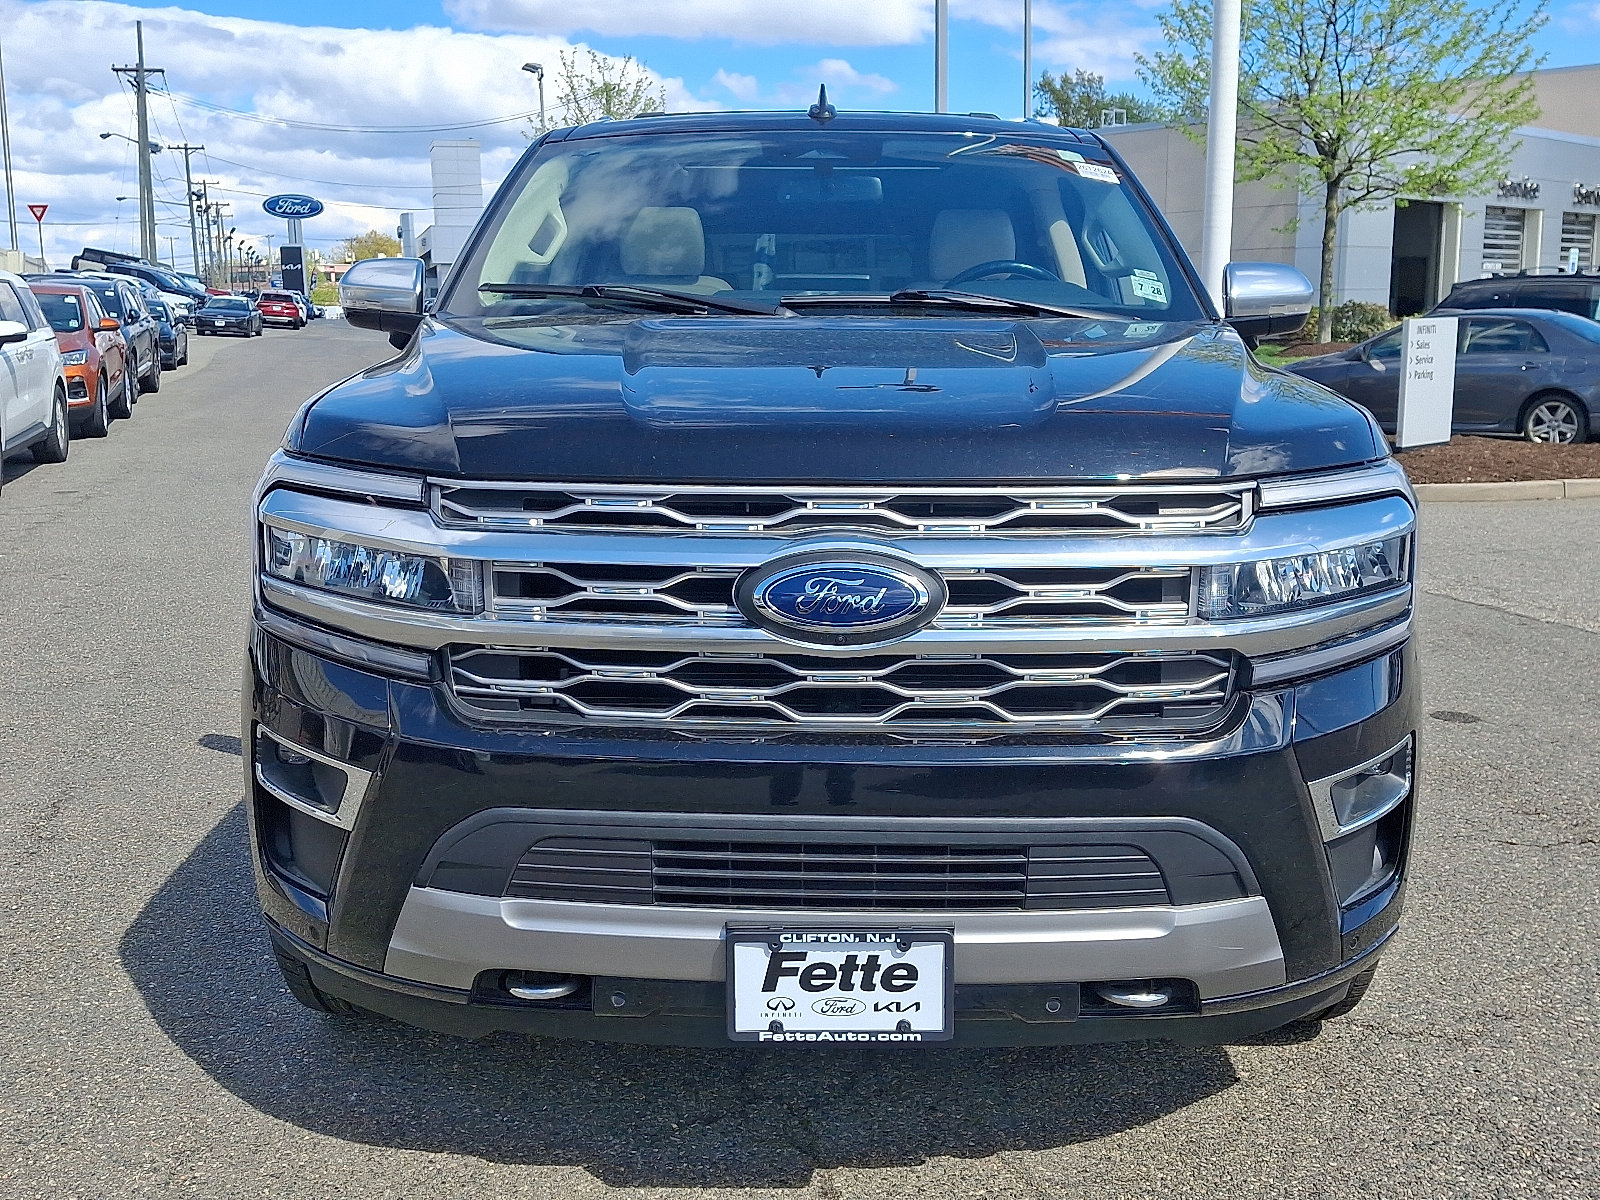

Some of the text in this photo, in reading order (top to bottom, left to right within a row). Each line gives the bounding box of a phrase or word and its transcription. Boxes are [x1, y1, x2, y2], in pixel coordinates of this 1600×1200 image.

[276, 198, 311, 214] Ford
[1137, 282, 1163, 296] 7 28
[1416, 339, 1431, 350] Sales
[1415, 354, 1434, 365] Service
[1414, 370, 1434, 381] Parking
[795, 576, 888, 615] Ford
[779, 933, 901, 943] CLIFTON, N.J.
[761, 951, 919, 993] Fette
[820, 999, 857, 1014] Ford
[873, 1001, 921, 1013] KIA
[758, 1031, 922, 1042] FetteAuto.com
